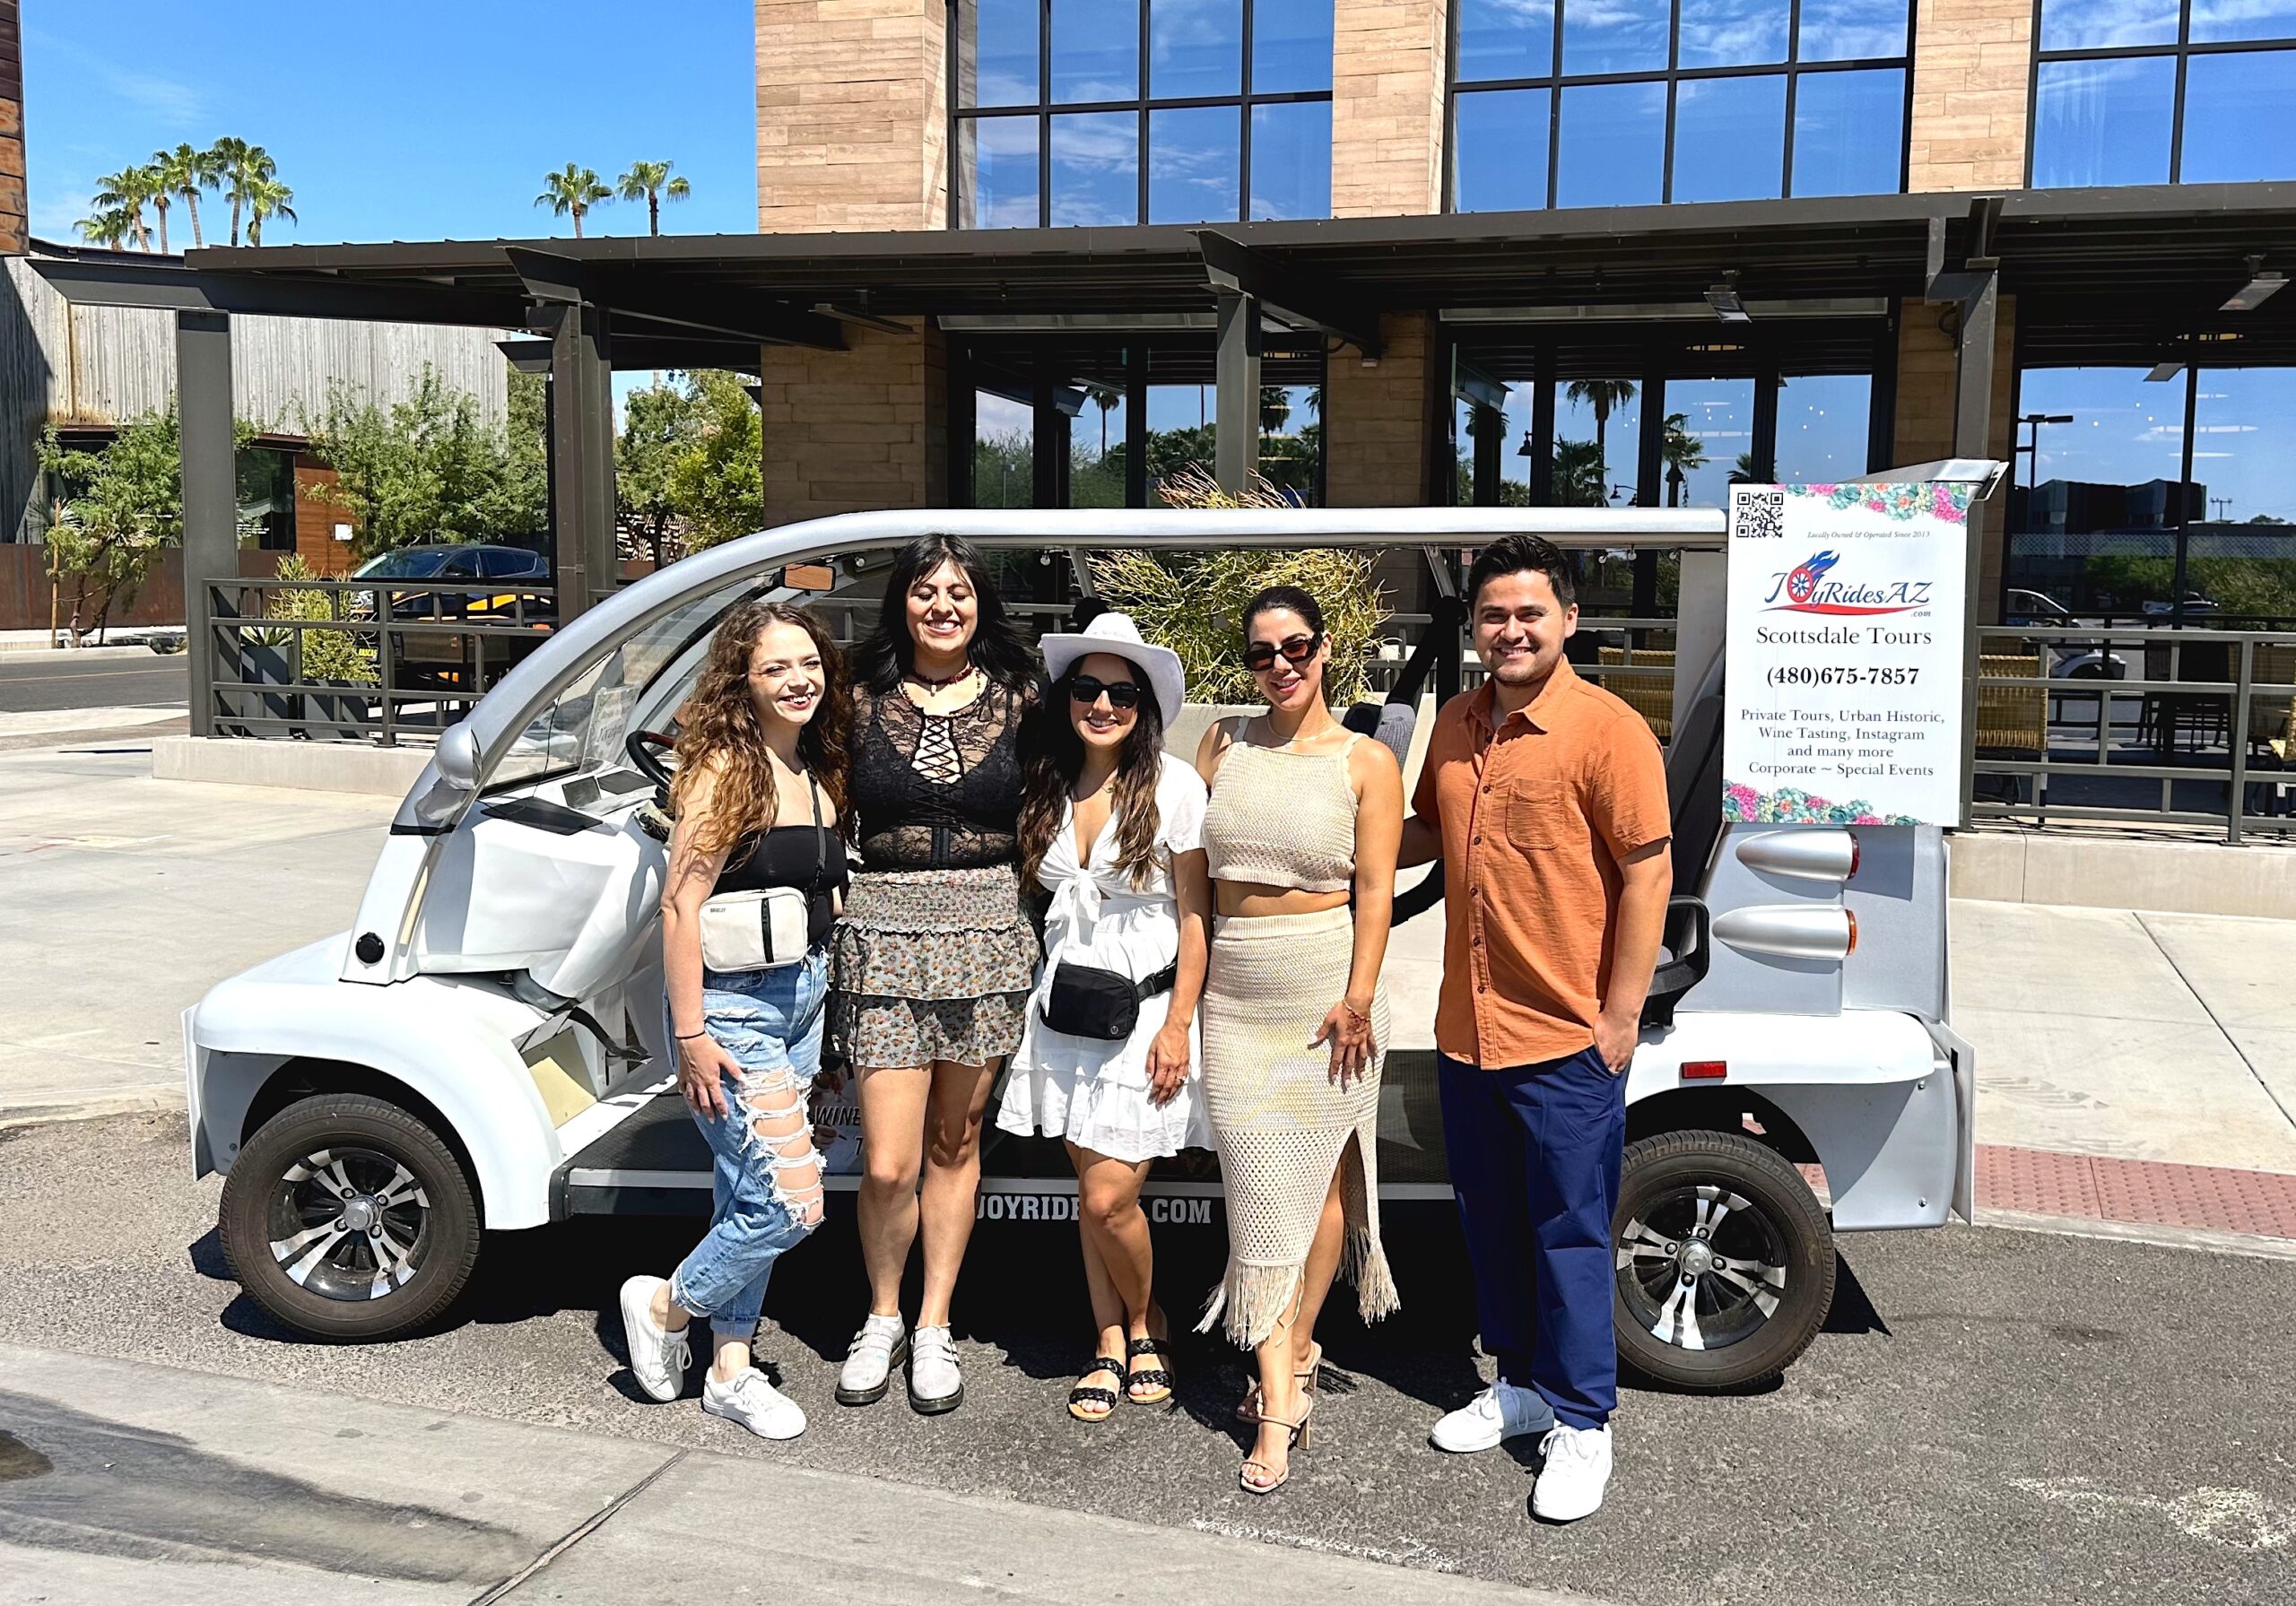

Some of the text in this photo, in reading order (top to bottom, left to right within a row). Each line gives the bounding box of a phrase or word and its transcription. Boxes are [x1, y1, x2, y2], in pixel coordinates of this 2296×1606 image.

[1756, 627, 1933, 645] Scottsdale Tours
[1767, 666, 1920, 689] (480)675-7857
[1741, 708, 1945, 725] Private Tours, Urban Historic,
[1758, 726, 1926, 743] Wine Tasting, Instagram
[1787, 745, 1894, 760] and many more
[1749, 761, 1817, 777] Corporate
[1837, 763, 1884, 777] Special
[1888, 763, 1935, 776] Events
